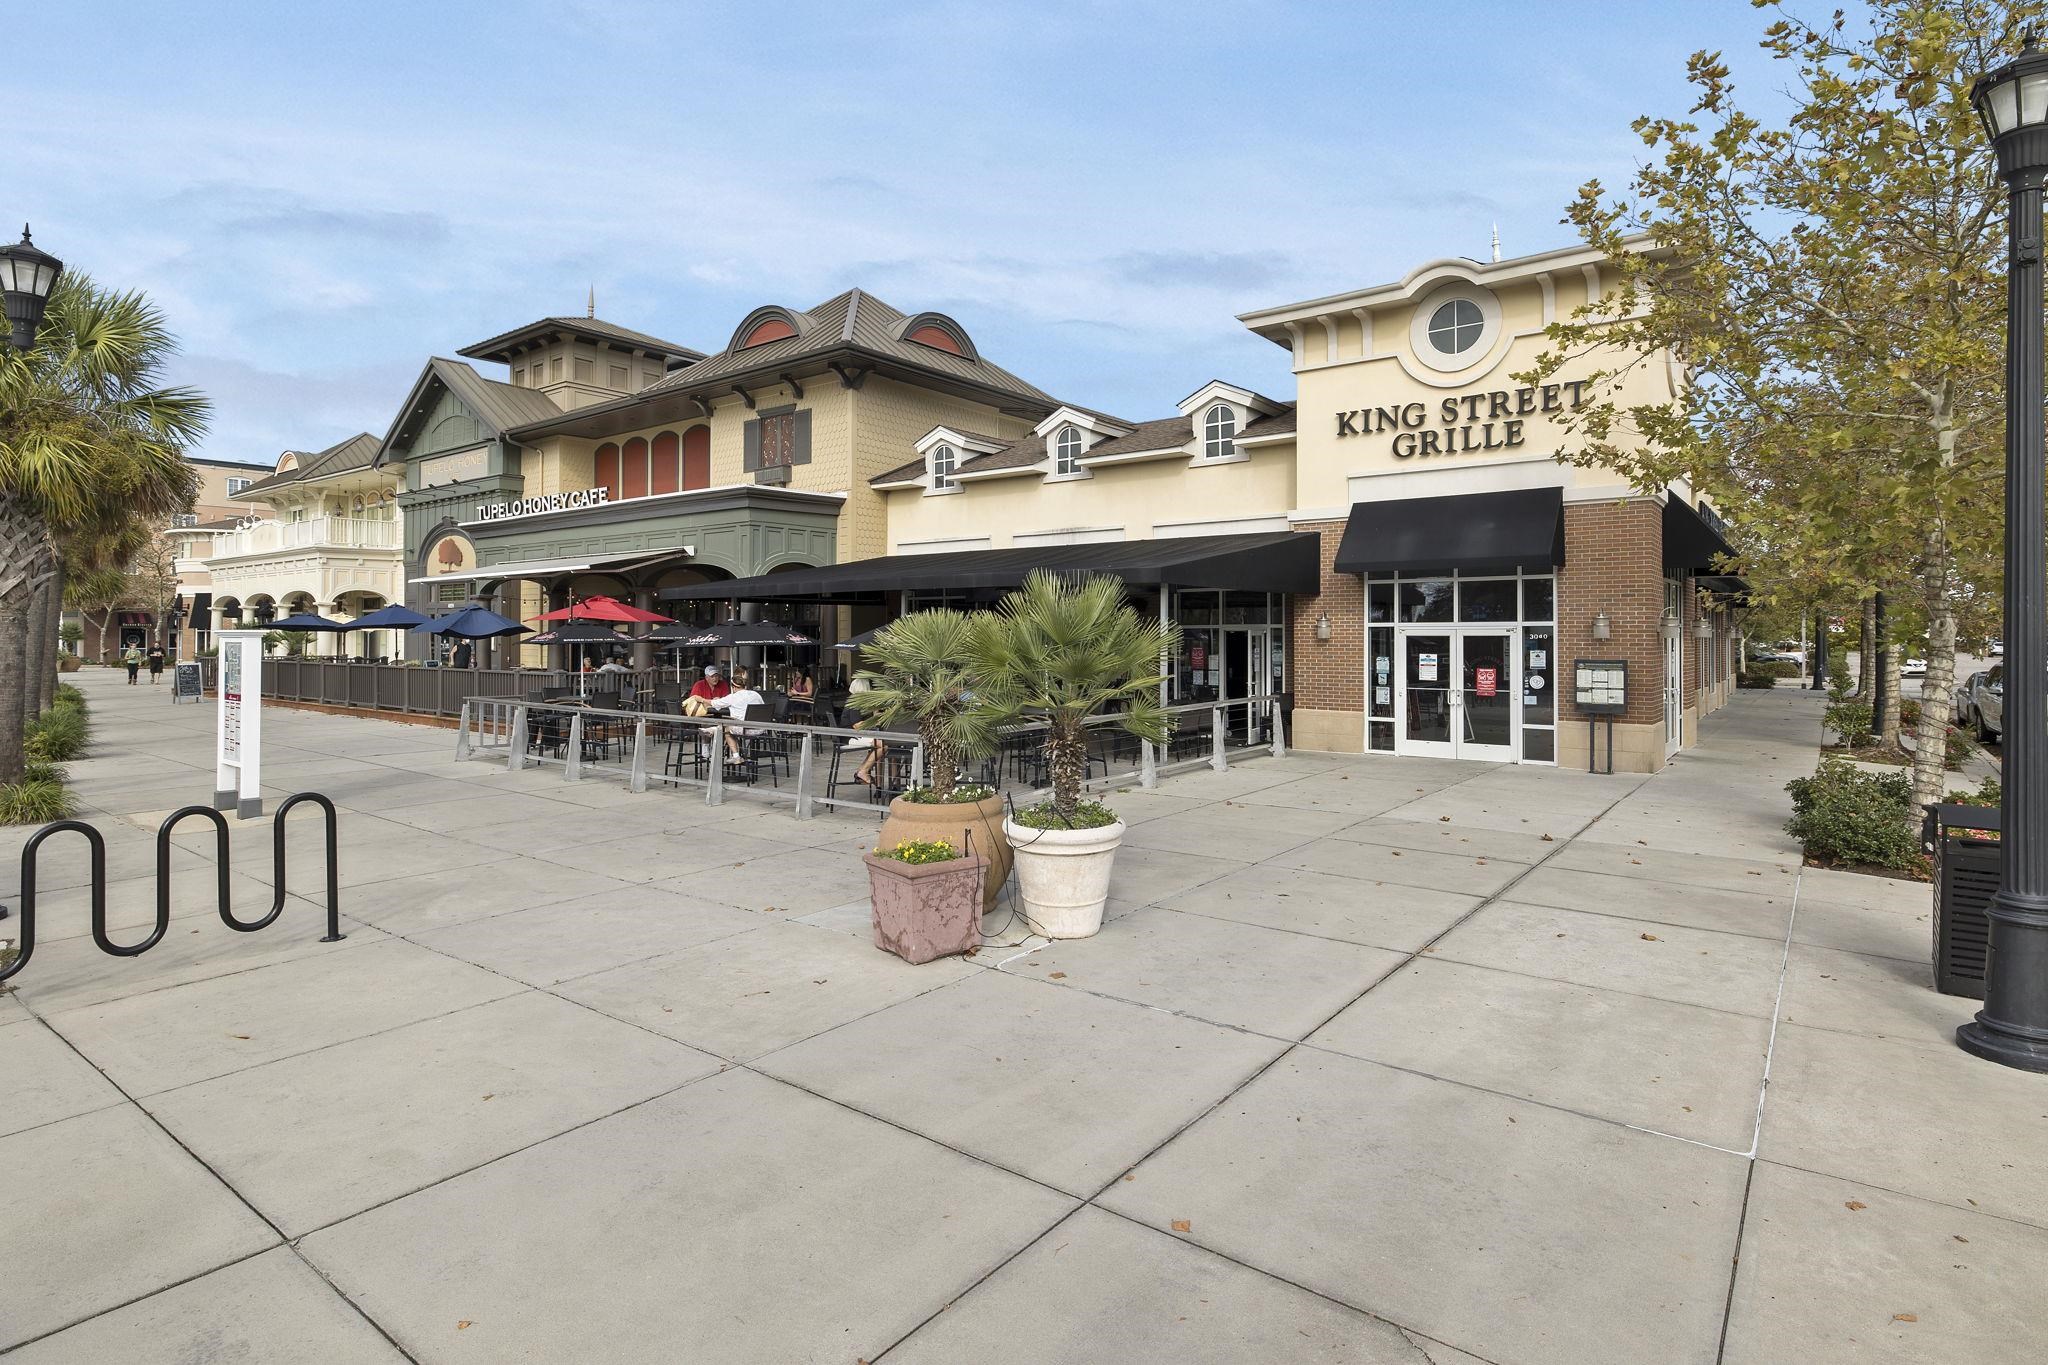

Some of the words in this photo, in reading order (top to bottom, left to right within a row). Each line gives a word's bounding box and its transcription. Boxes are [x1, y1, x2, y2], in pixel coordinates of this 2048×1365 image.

[1335, 402, 1427, 437] KING
[1441, 379, 1590, 424] STREET
[1391, 419, 1526, 458] GRILLE
[476, 500, 522, 521] TUPELO
[523, 492, 570, 515] HONEY
[570, 486, 609, 507] CAFE
